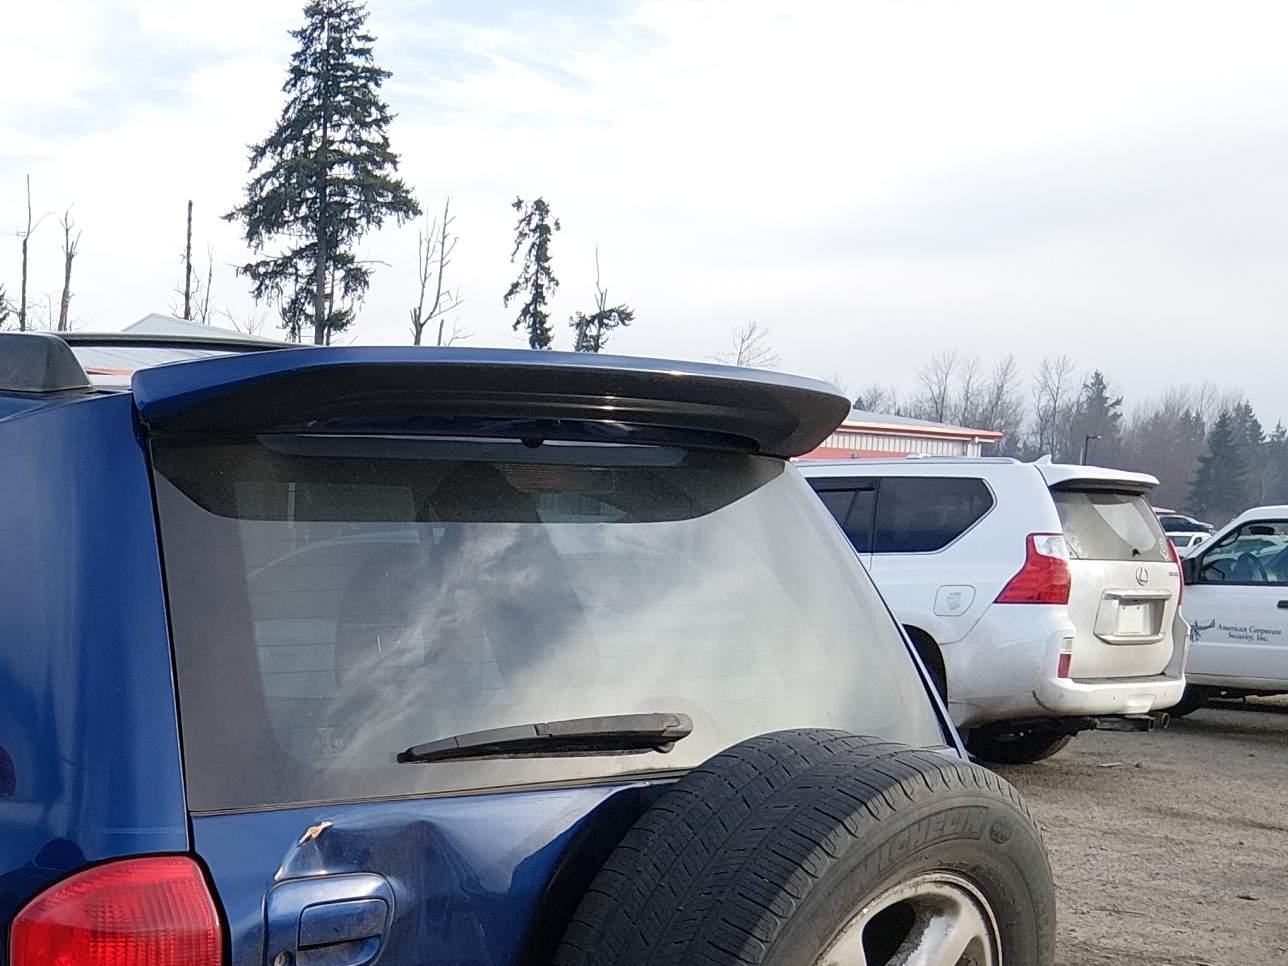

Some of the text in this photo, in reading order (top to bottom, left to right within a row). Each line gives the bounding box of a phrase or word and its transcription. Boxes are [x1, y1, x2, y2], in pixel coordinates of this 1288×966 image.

[1218, 624, 1282, 636] American Corporate
[1256, 633, 1270, 642] Inc.
